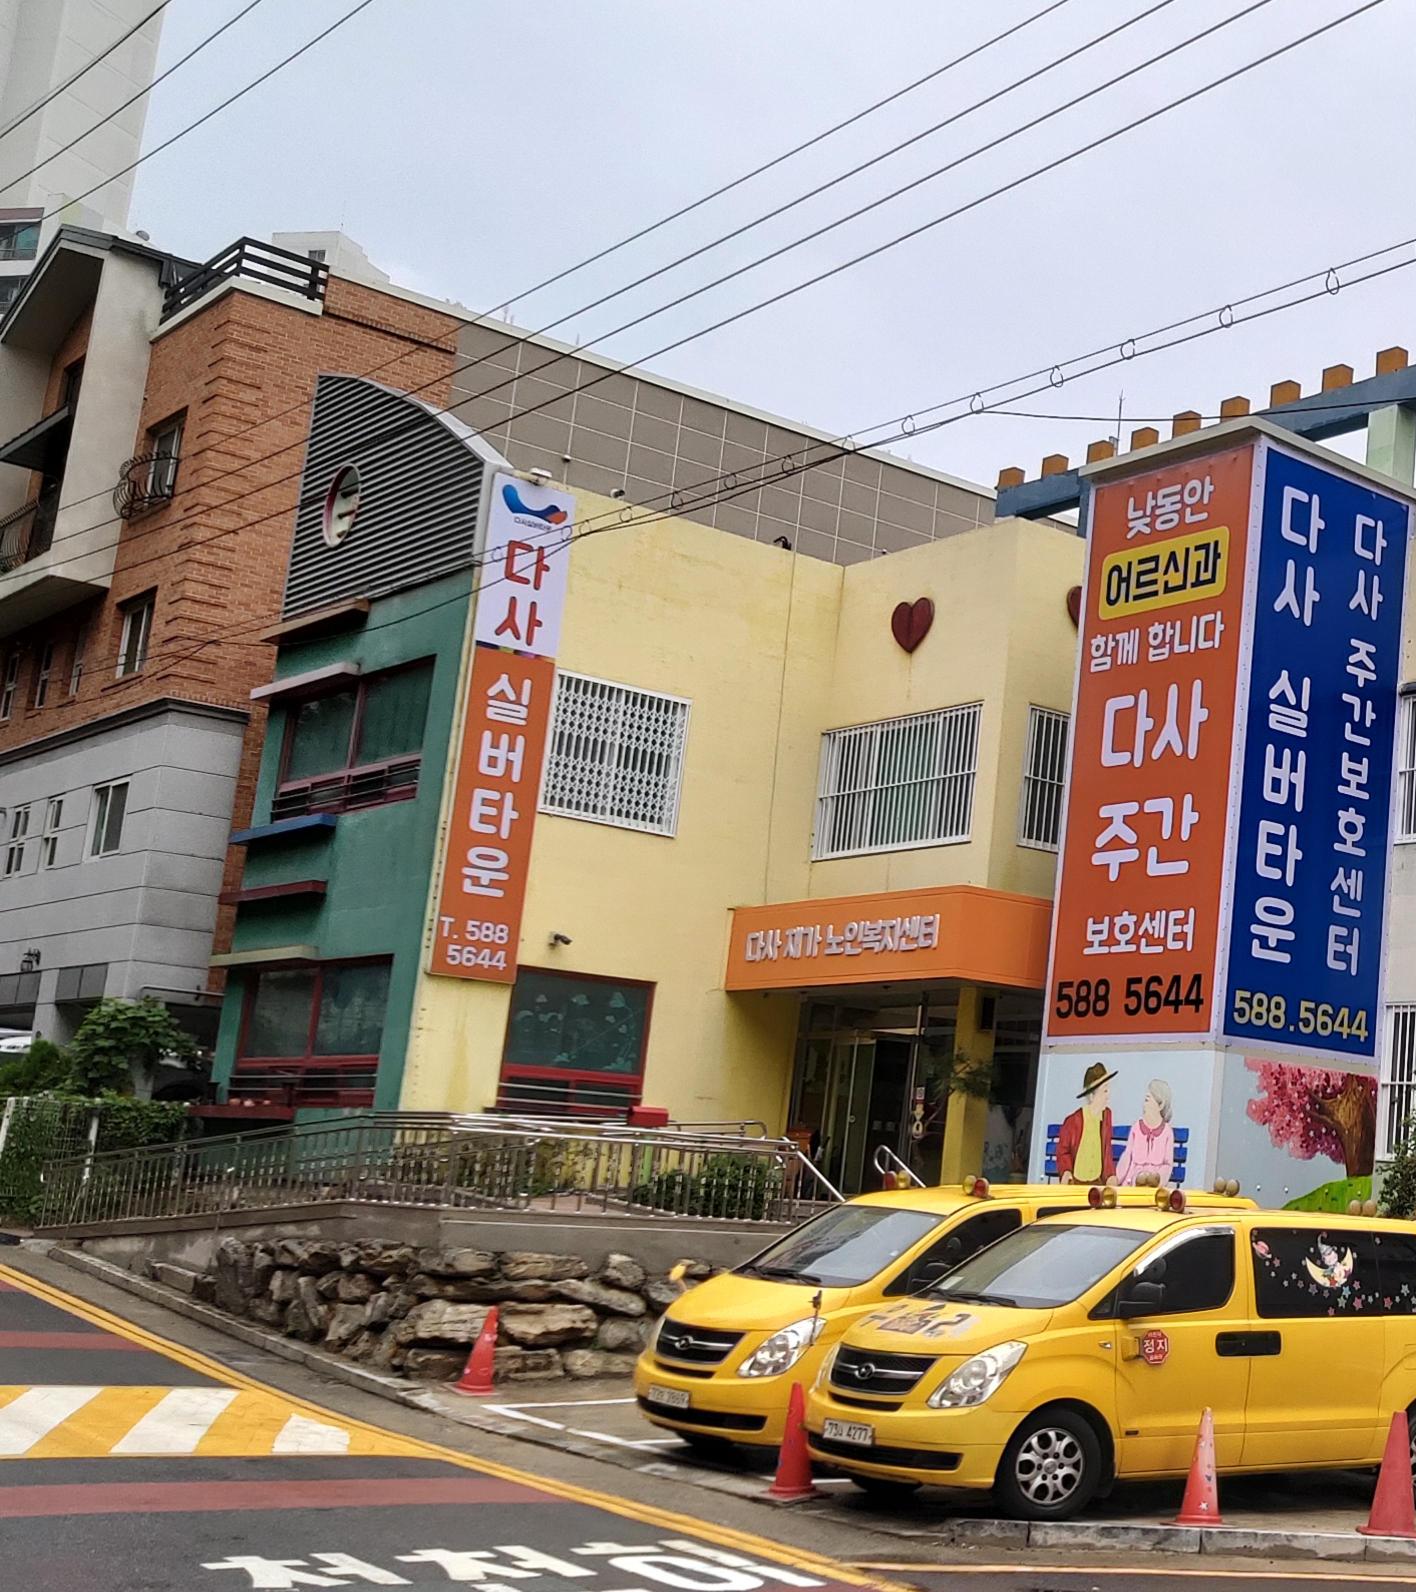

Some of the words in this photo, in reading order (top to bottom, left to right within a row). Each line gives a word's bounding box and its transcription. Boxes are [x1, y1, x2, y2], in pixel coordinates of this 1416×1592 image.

[1126, 475, 1214, 540] 낮동안
[1105, 540, 1221, 607] 어르신과
[1273, 485, 1325, 627] 다사
[1349, 513, 1387, 621] 다사
[494, 539, 550, 646] 다사
[1090, 627, 1139, 673] 함께
[1147, 610, 1224, 661] 합니다
[1100, 678, 1209, 768] 다사
[461, 673, 532, 898] 실버타운
[1249, 669, 1311, 964] 실버타운
[1325, 638, 1377, 977] 주간보호센터
[1091, 793, 1199, 882] 주간
[446, 944, 507, 971] 5644
[465, 921, 509, 945] 588
[745, 929, 782, 962] 다사
[783, 924, 822, 959] 재가
[824, 913, 940, 956] 노인복지센터
[1082, 906, 1195, 956] 보호센터
[1055, 978, 1110, 1019] 588
[1124, 973, 1204, 1016] 5644
[1143, 1338, 1168, 1353] 정지
